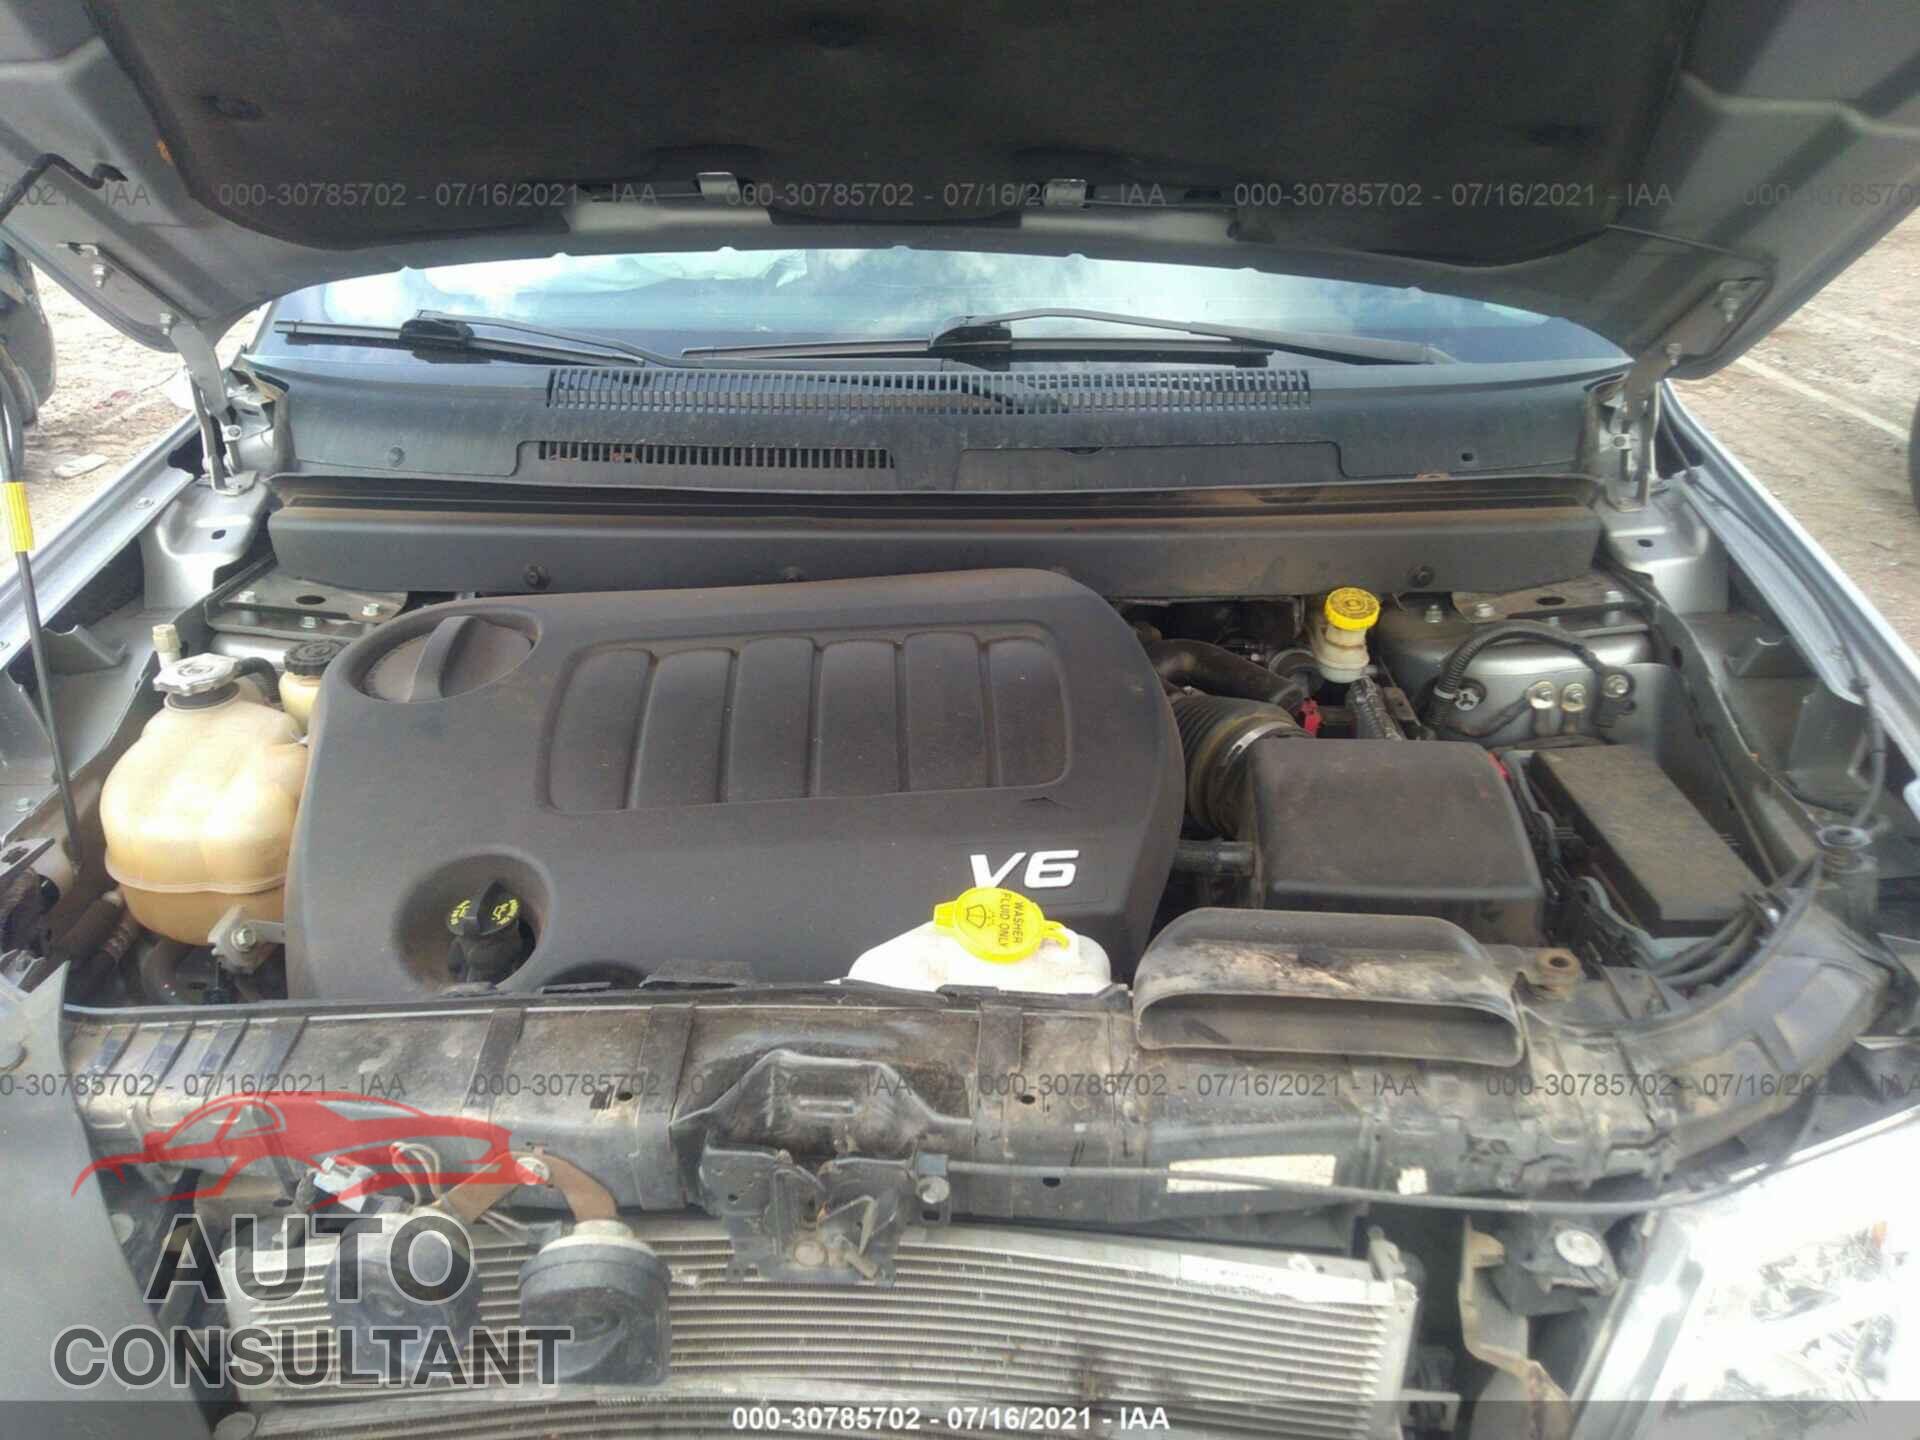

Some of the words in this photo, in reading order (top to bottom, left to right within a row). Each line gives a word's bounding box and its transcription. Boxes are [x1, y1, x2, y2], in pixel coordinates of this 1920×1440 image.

[970, 850, 1080, 889] V6
[1000, 893, 1012, 921] FLUID
[1013, 901, 1025, 944] WASHER
[998, 923, 1010, 948] ONLY
